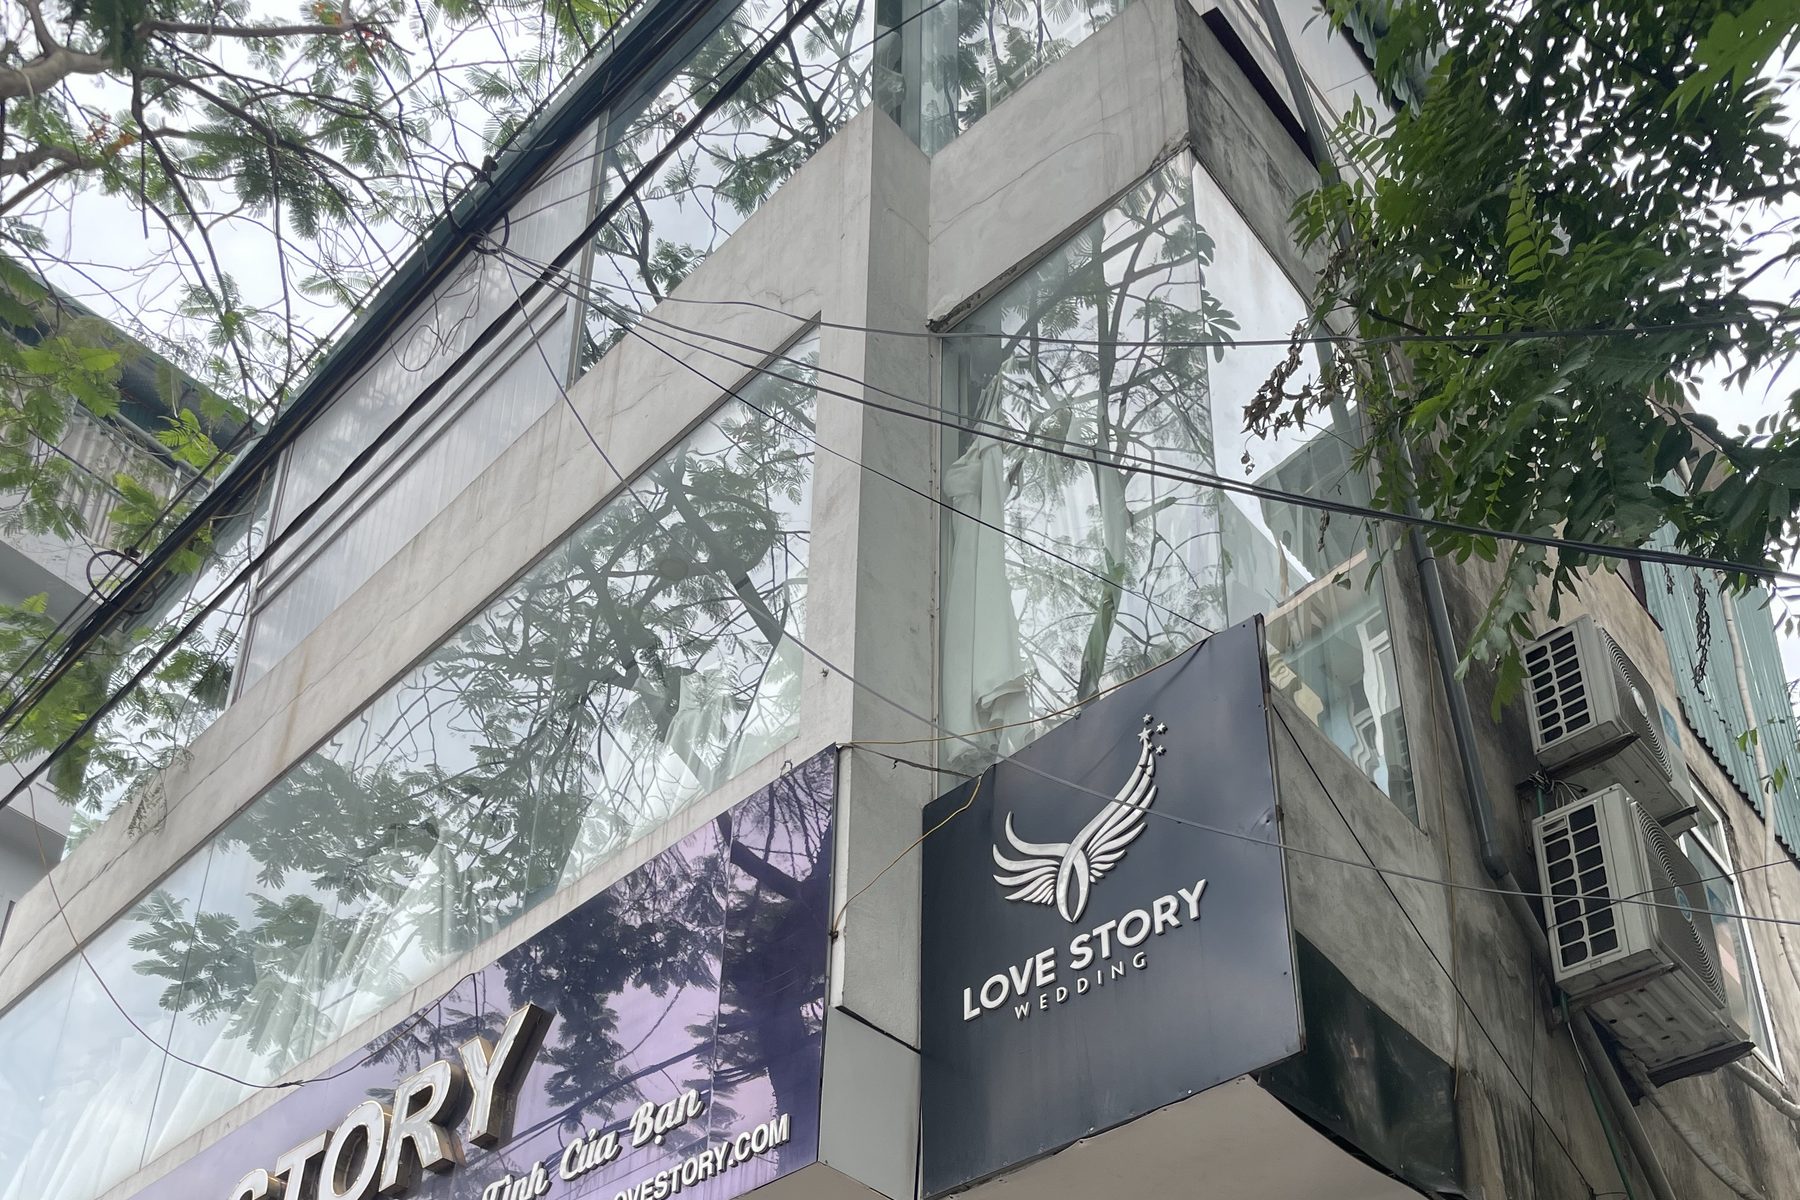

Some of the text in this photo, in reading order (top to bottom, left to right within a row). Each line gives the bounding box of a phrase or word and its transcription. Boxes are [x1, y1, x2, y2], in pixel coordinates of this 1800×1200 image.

[963, 878, 1208, 1021] LOVE STORY
[1014, 951, 1148, 1020] WEDDING
[629, 1088, 704, 1148] Bạn
